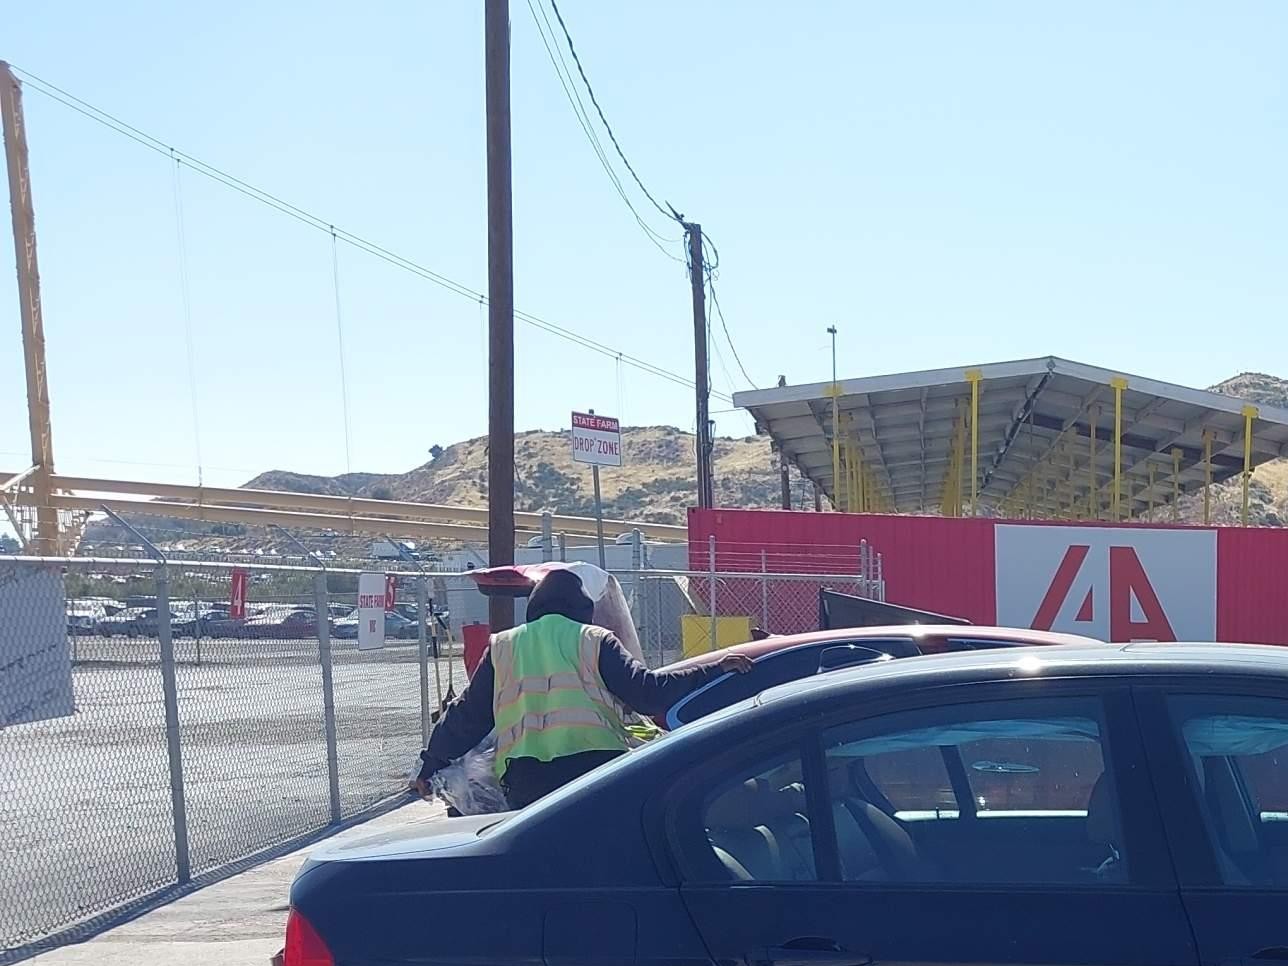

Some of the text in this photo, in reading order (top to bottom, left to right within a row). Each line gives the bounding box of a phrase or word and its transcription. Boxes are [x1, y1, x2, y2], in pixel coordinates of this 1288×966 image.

[573, 415, 619, 430] STATE FARM
[574, 436, 619, 456] DROP ZONE
[233, 574, 243, 616] 4
